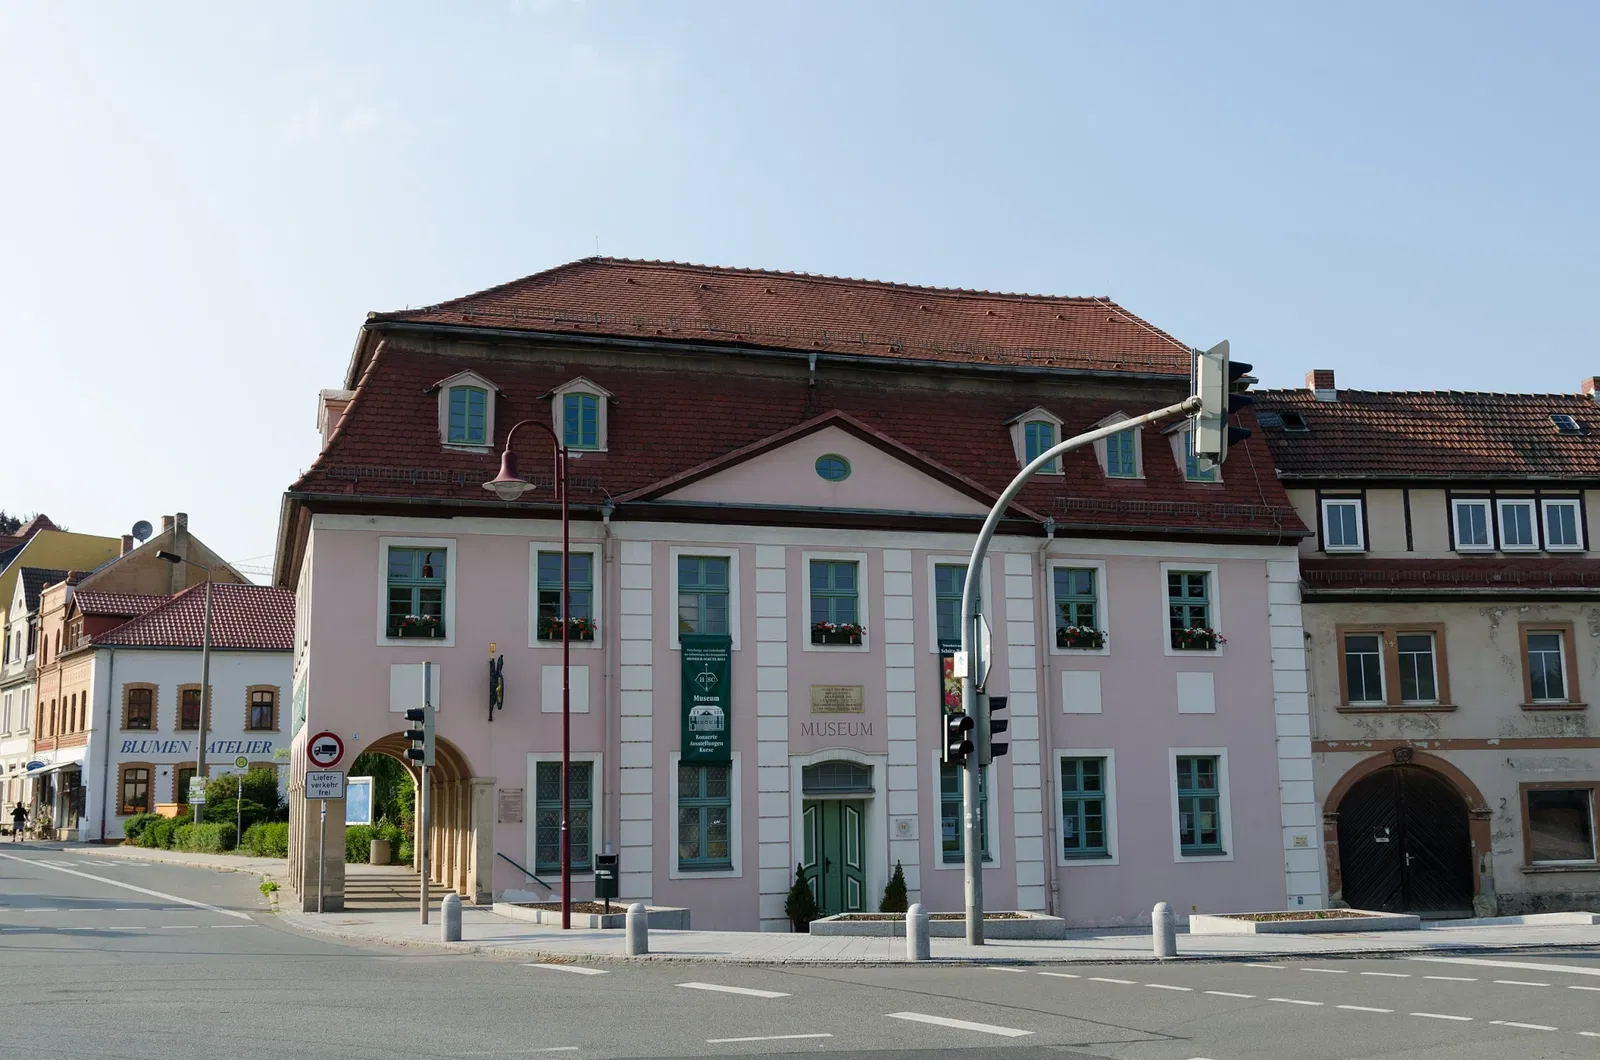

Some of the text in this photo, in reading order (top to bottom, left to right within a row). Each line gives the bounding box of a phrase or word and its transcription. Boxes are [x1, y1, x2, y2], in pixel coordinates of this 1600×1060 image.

[801, 722, 874, 736] MUSEUM
[120, 740, 273, 754] BLUMEN ATELIER
